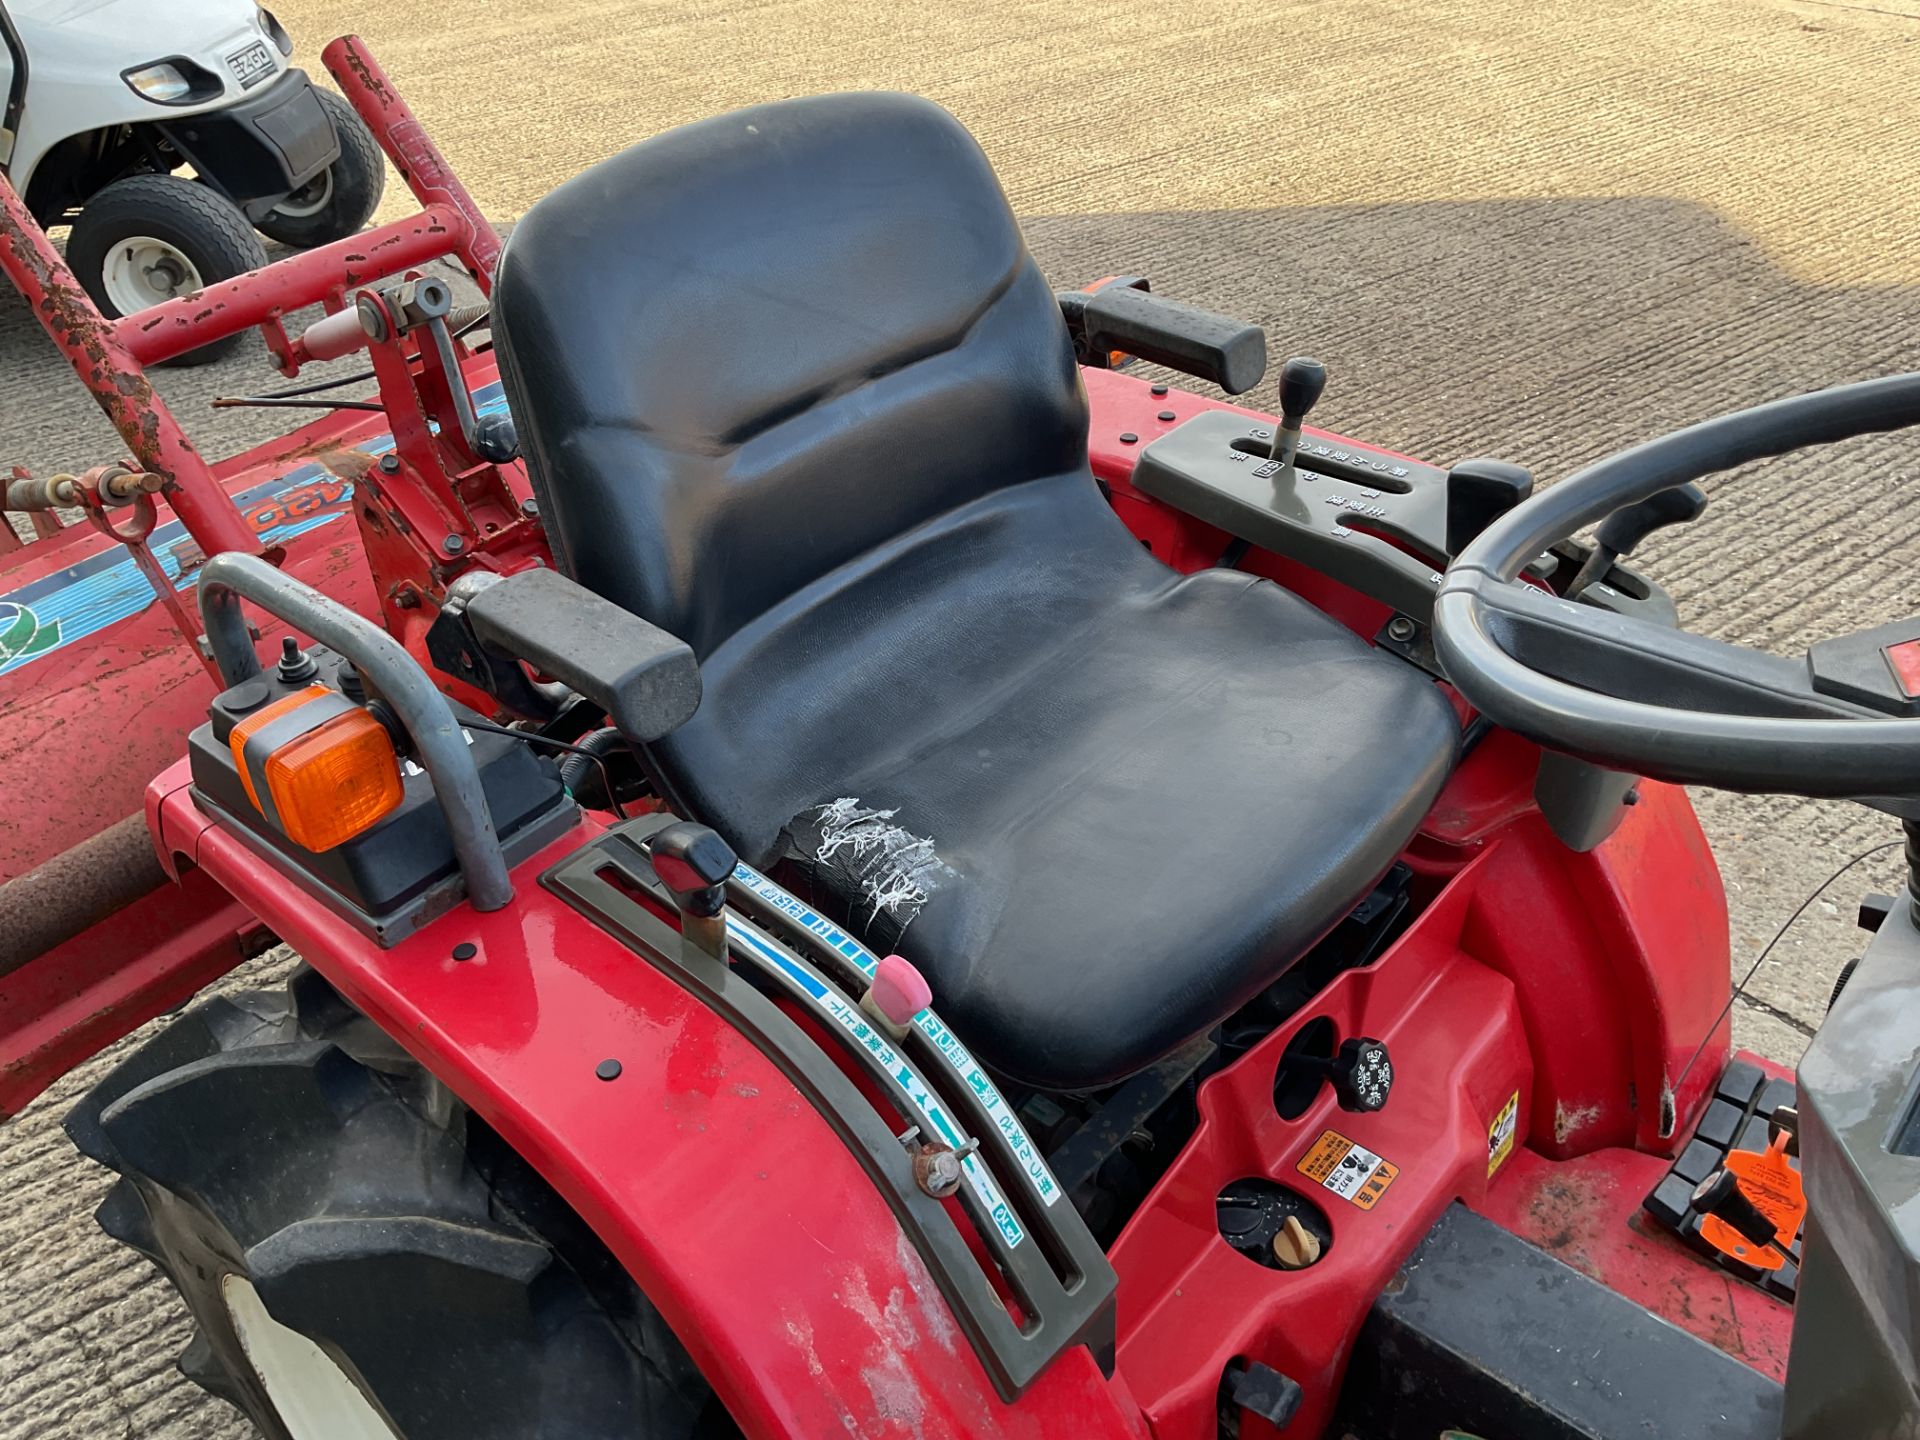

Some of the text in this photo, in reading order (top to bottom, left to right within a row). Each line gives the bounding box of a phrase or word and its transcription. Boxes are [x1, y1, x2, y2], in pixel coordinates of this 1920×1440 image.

[828, 999, 897, 1067] 作業機上下
[923, 1018, 968, 1068] 耕うん
[1366, 1050, 1382, 1061] FAST
[967, 1071, 996, 1105] 深い
[998, 1116, 1054, 1196] 耕うん深さ
